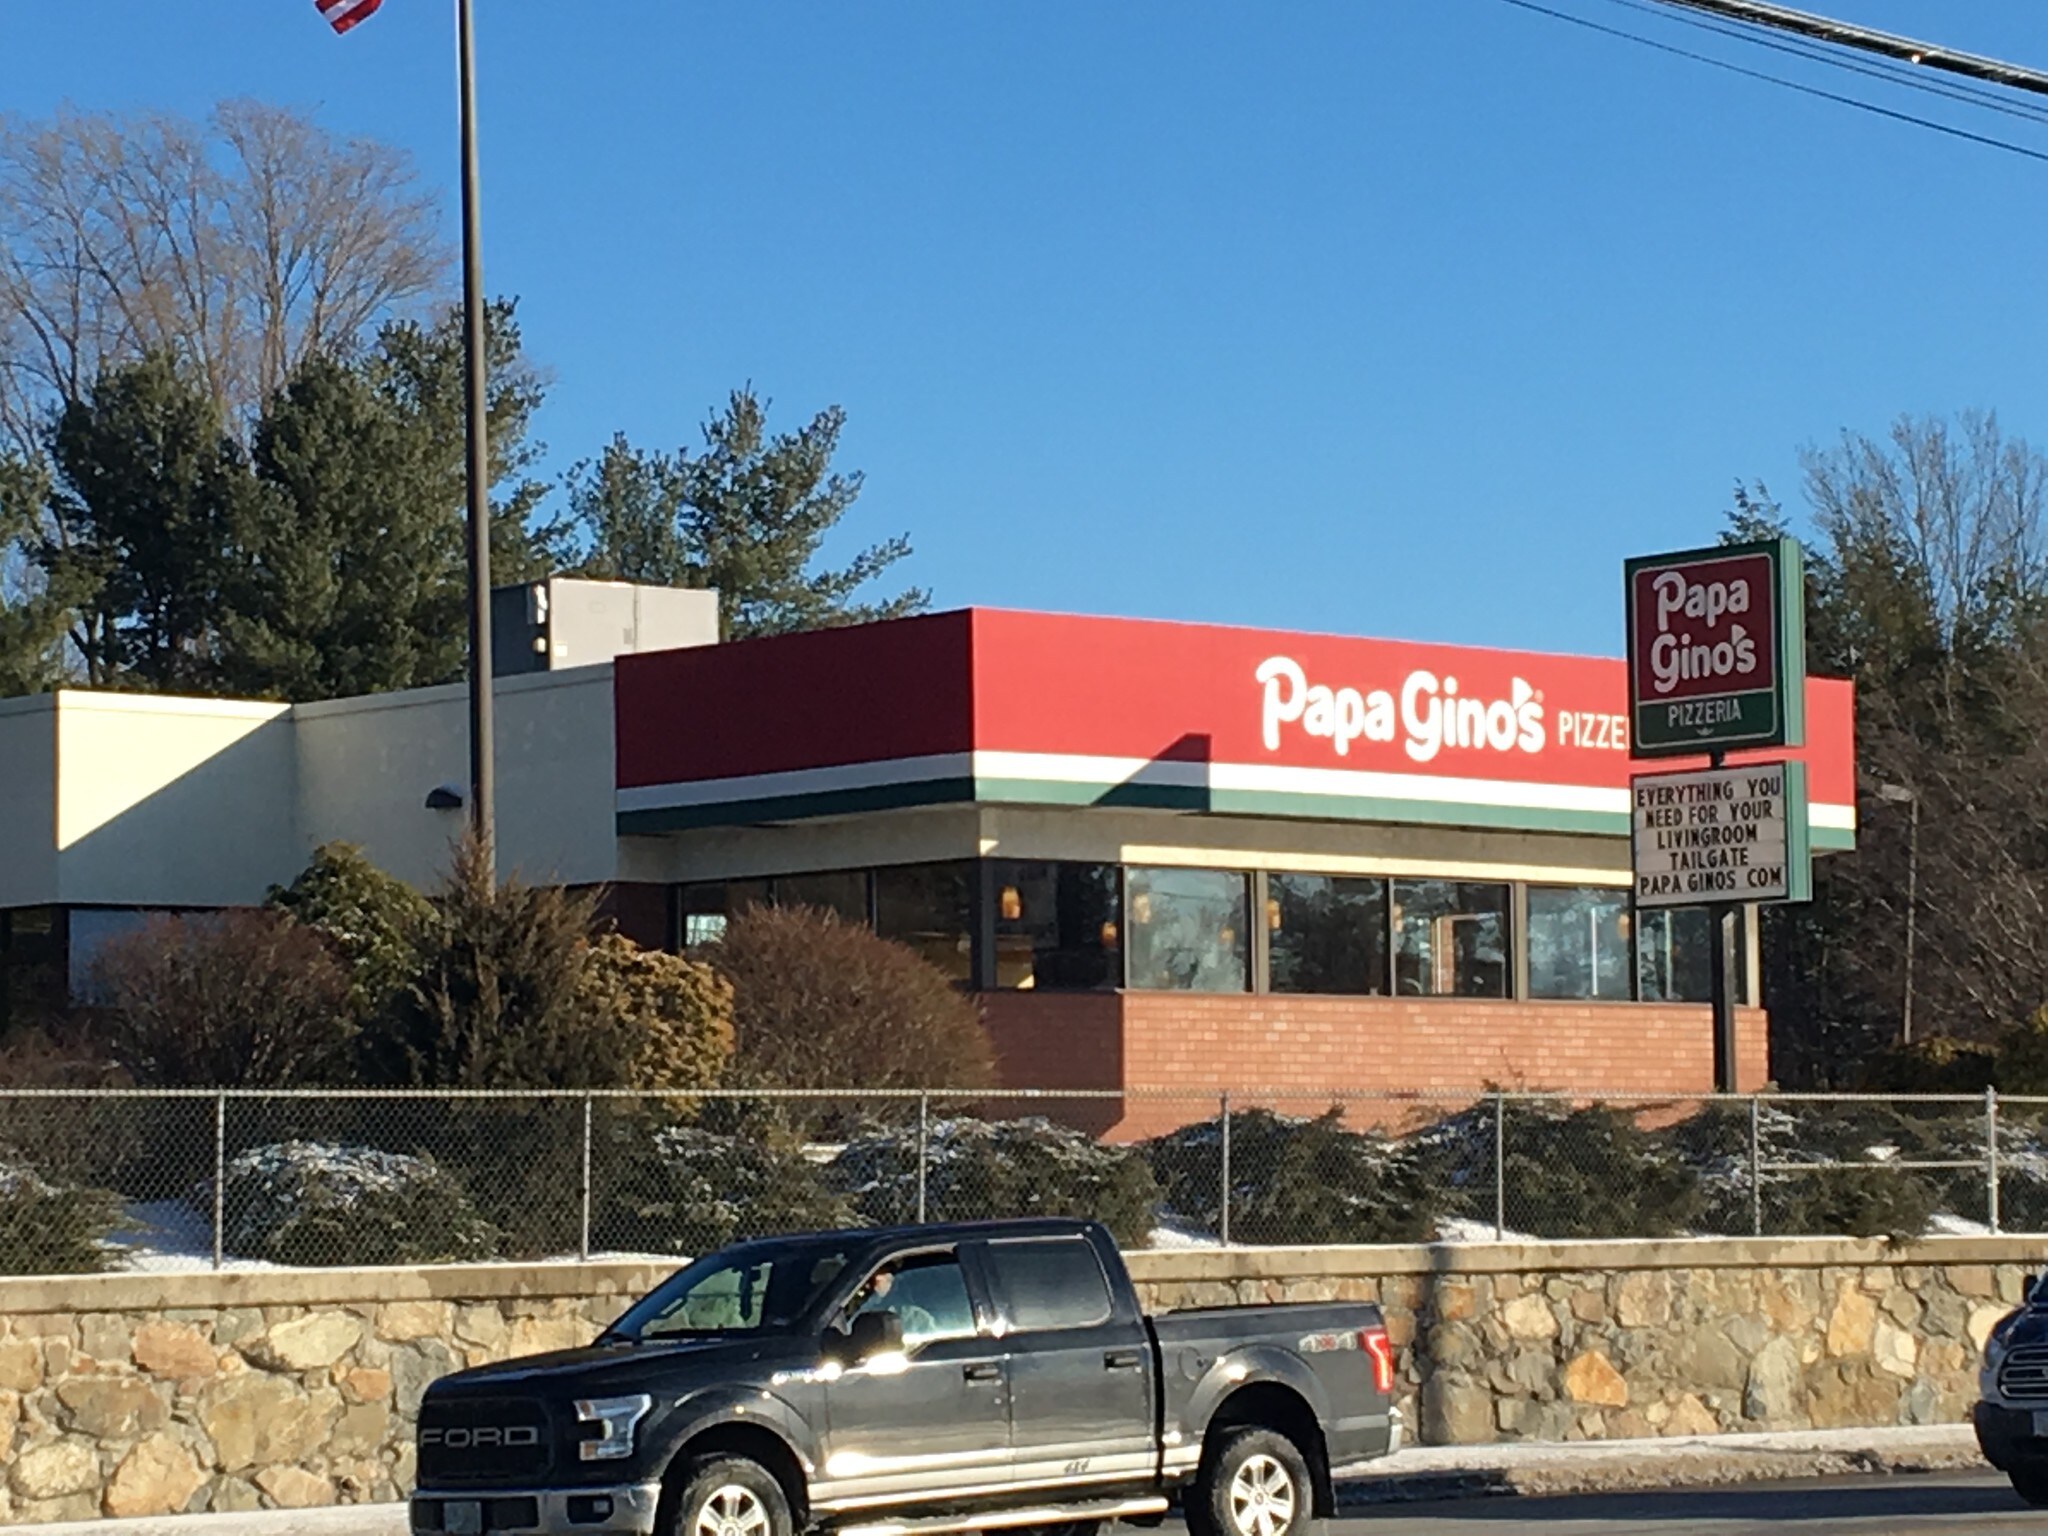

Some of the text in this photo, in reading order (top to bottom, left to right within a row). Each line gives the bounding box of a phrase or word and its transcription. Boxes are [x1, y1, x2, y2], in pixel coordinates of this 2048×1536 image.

[1653, 571, 1749, 632] Papa
[1651, 624, 1757, 693] Gino's
[1255, 655, 1629, 762] Papa Gino's PIZZE
[1668, 698, 1742, 727] PIZZERIA
[1637, 776, 1780, 807] EVERYTHING YOU
[1646, 801, 1772, 828] NEED FOR YOUR
[1657, 823, 1758, 850] LIVINGROOM
[1669, 847, 1749, 871] TAILGATE
[420, 1426, 538, 1447] FORD
